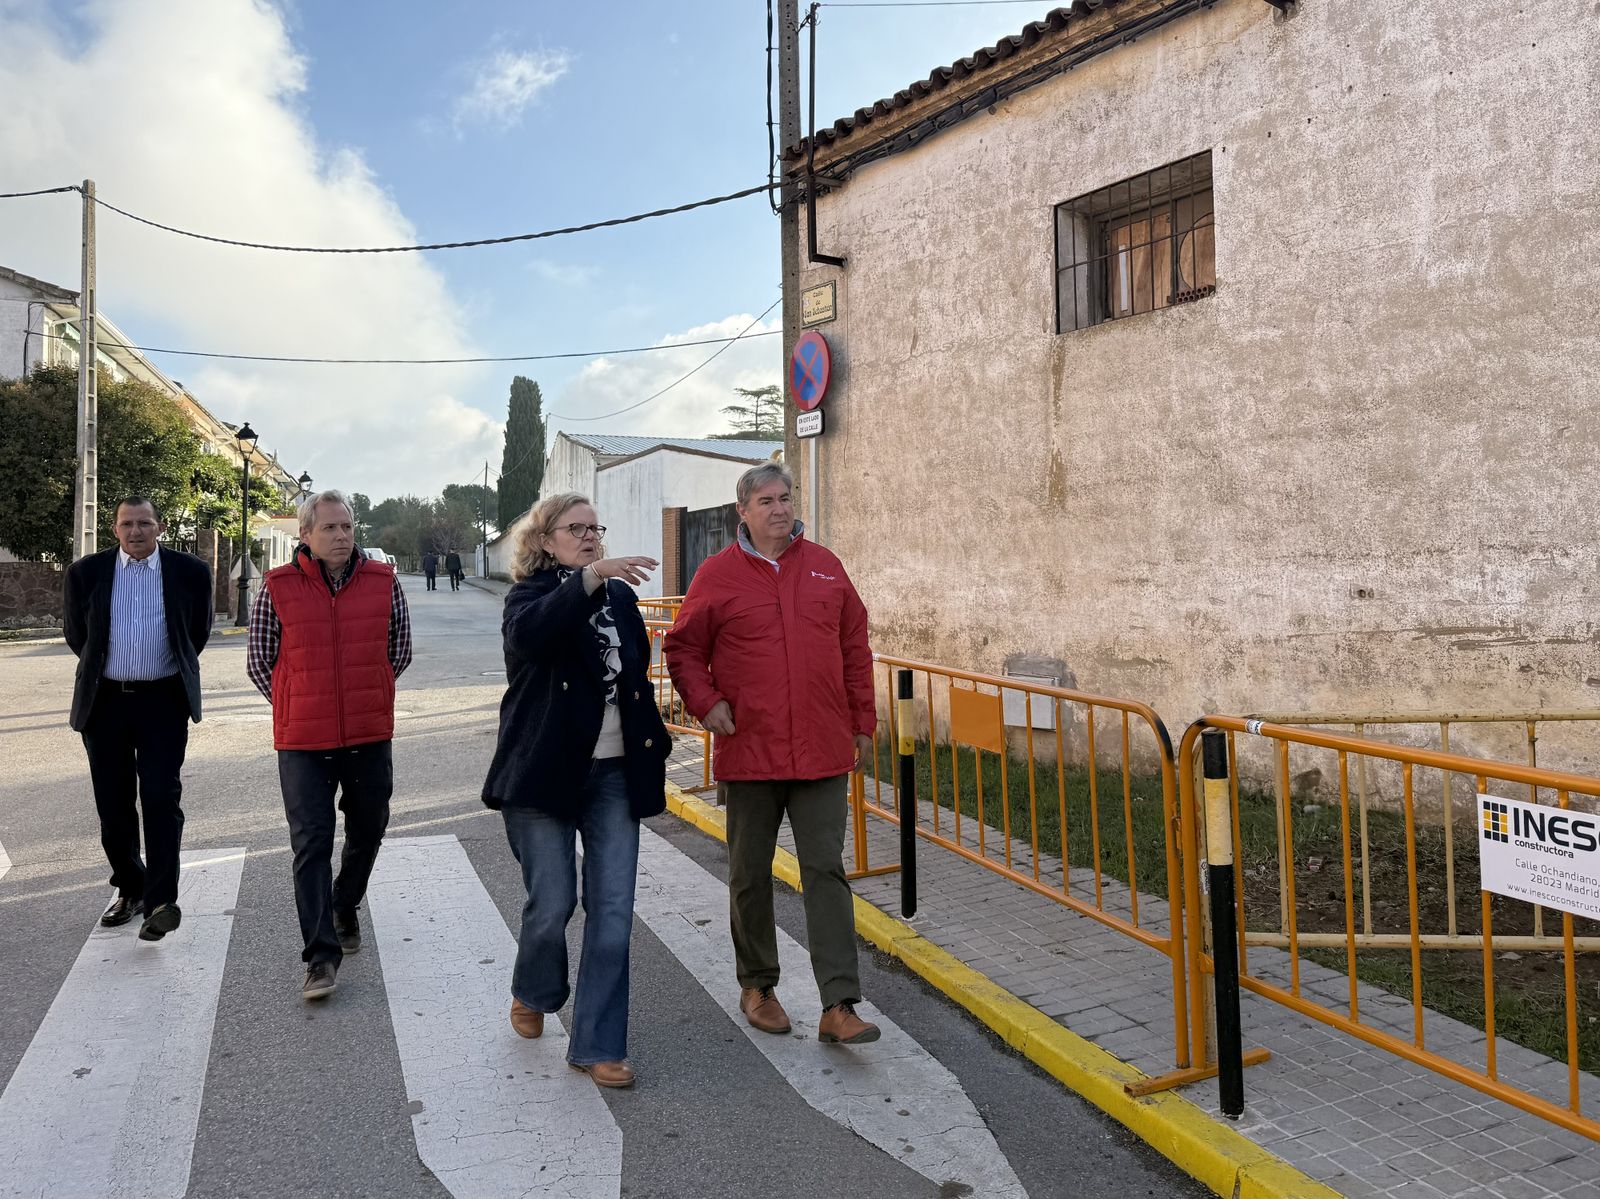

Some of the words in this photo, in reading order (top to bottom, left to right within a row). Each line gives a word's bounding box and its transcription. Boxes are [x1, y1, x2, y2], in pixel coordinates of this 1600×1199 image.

[808, 423, 818, 432] CALLE
[1513, 806, 1600, 852] INES
[1514, 839, 1574, 859] constructora
[1515, 858, 1538, 872] Calle
[1530, 873, 1562, 889] 28023
[1565, 881, 1600, 899] Madrid
[1507, 882, 1600, 914] www.inescoconstruct
